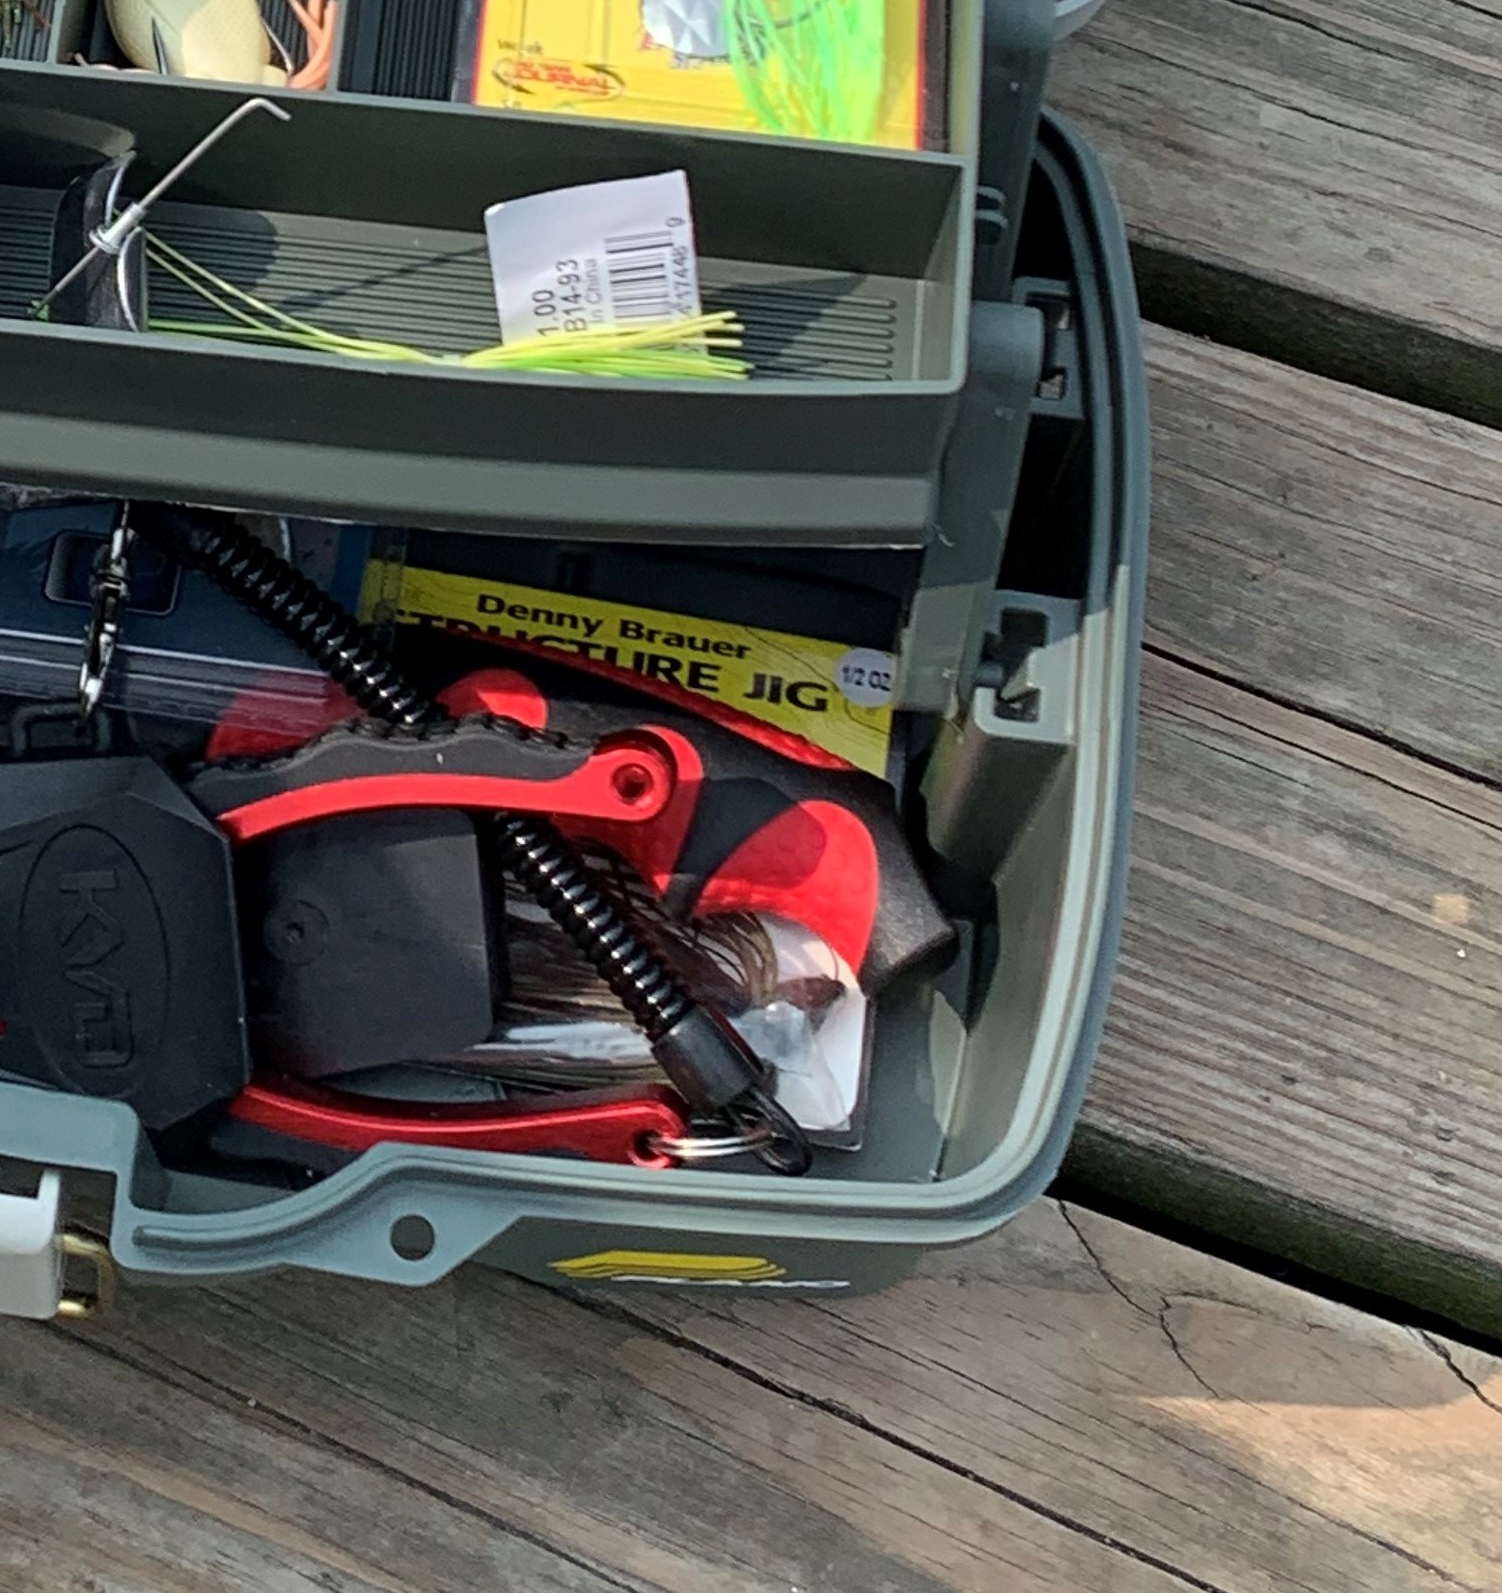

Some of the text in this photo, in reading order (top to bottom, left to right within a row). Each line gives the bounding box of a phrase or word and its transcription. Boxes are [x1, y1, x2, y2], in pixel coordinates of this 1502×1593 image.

[584, 258, 604, 304] China
[476, 594, 753, 660] Denny Brauer
[393, 608, 830, 713] TTURE JIG
